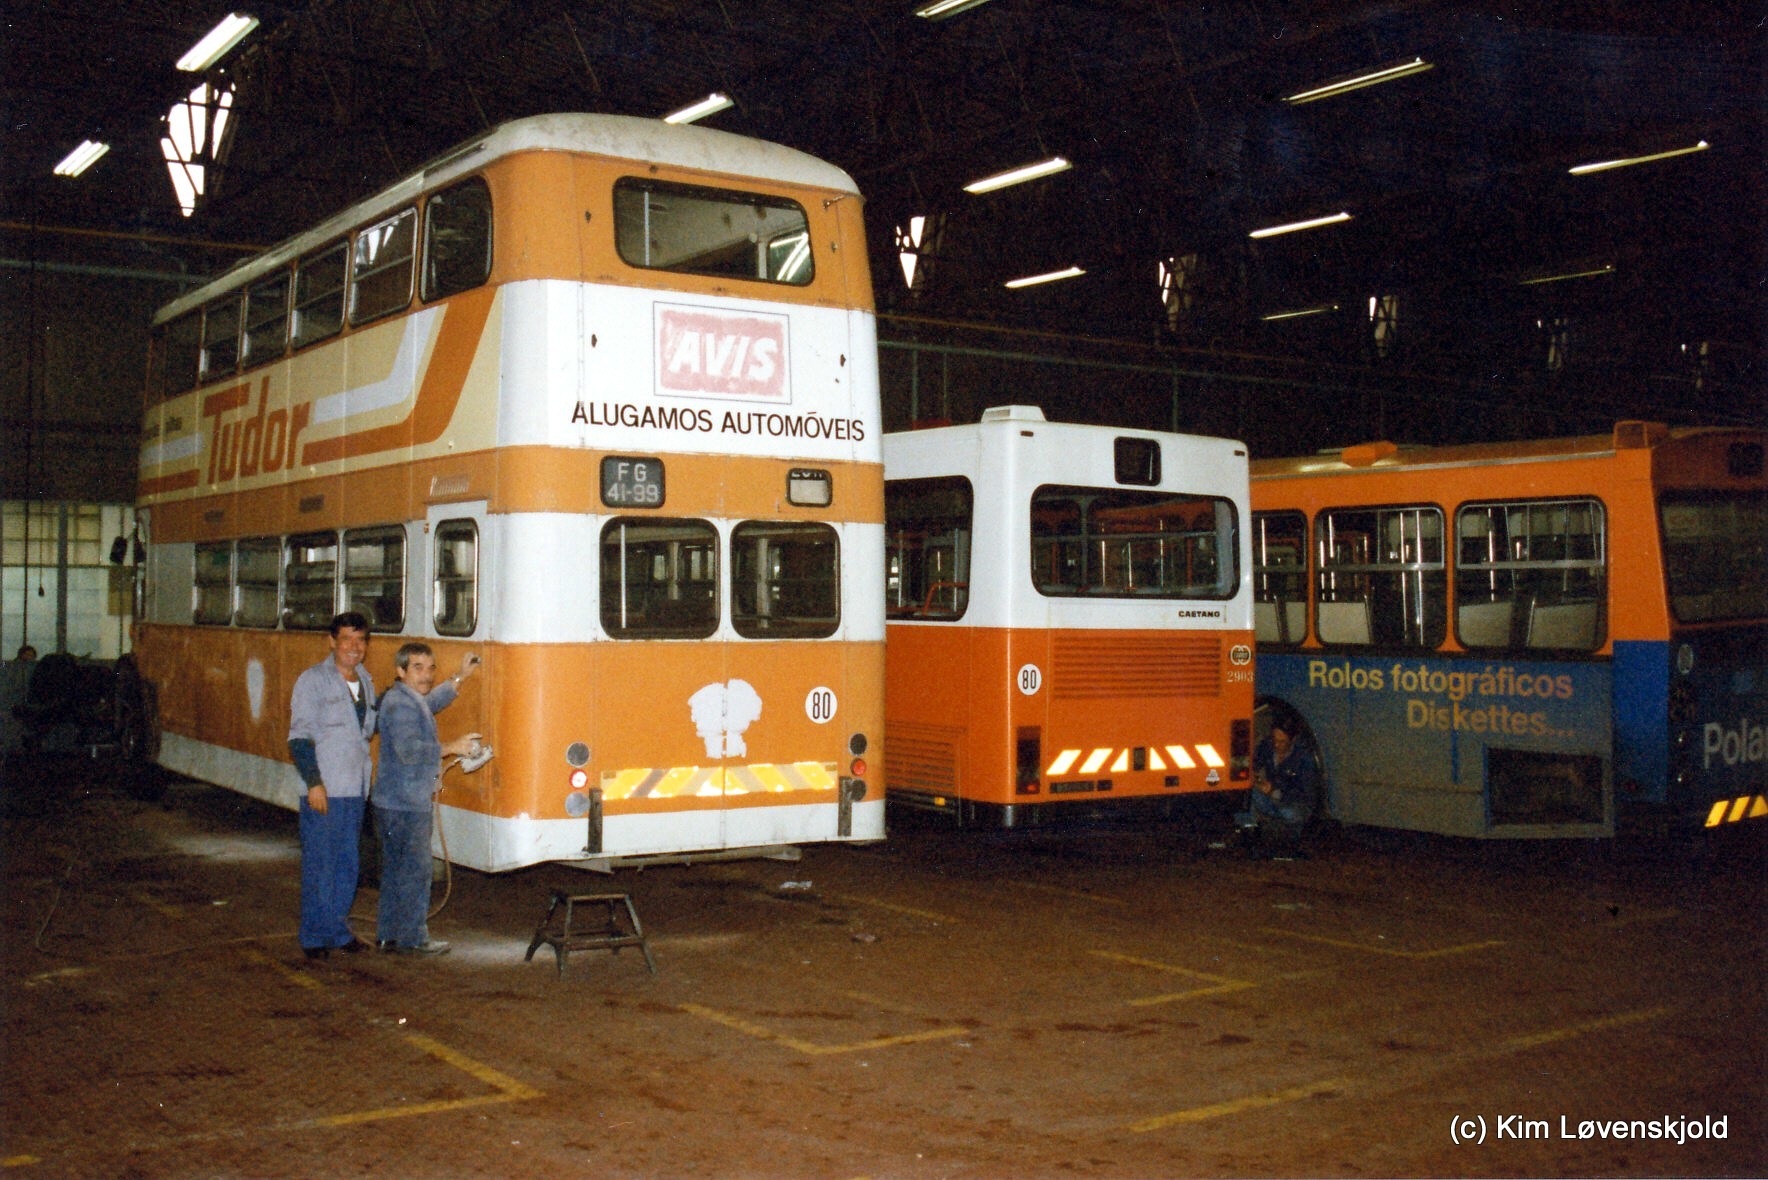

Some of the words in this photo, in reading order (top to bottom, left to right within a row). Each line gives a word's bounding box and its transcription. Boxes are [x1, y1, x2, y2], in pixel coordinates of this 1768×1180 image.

[668, 331, 776, 381] AVIS
[203, 376, 310, 484] Tudor
[571, 401, 713, 432] ALUGAMOS
[721, 411, 865, 442] AUTOMÓVEIS
[607, 483, 659, 503] 41-99
[1178, 610, 1221, 618] CAETANO
[1022, 669, 1037, 690] 80
[1309, 660, 1385, 690] Rolos
[1391, 664, 1574, 701] fotográficos
[812, 692, 831, 720] 80
